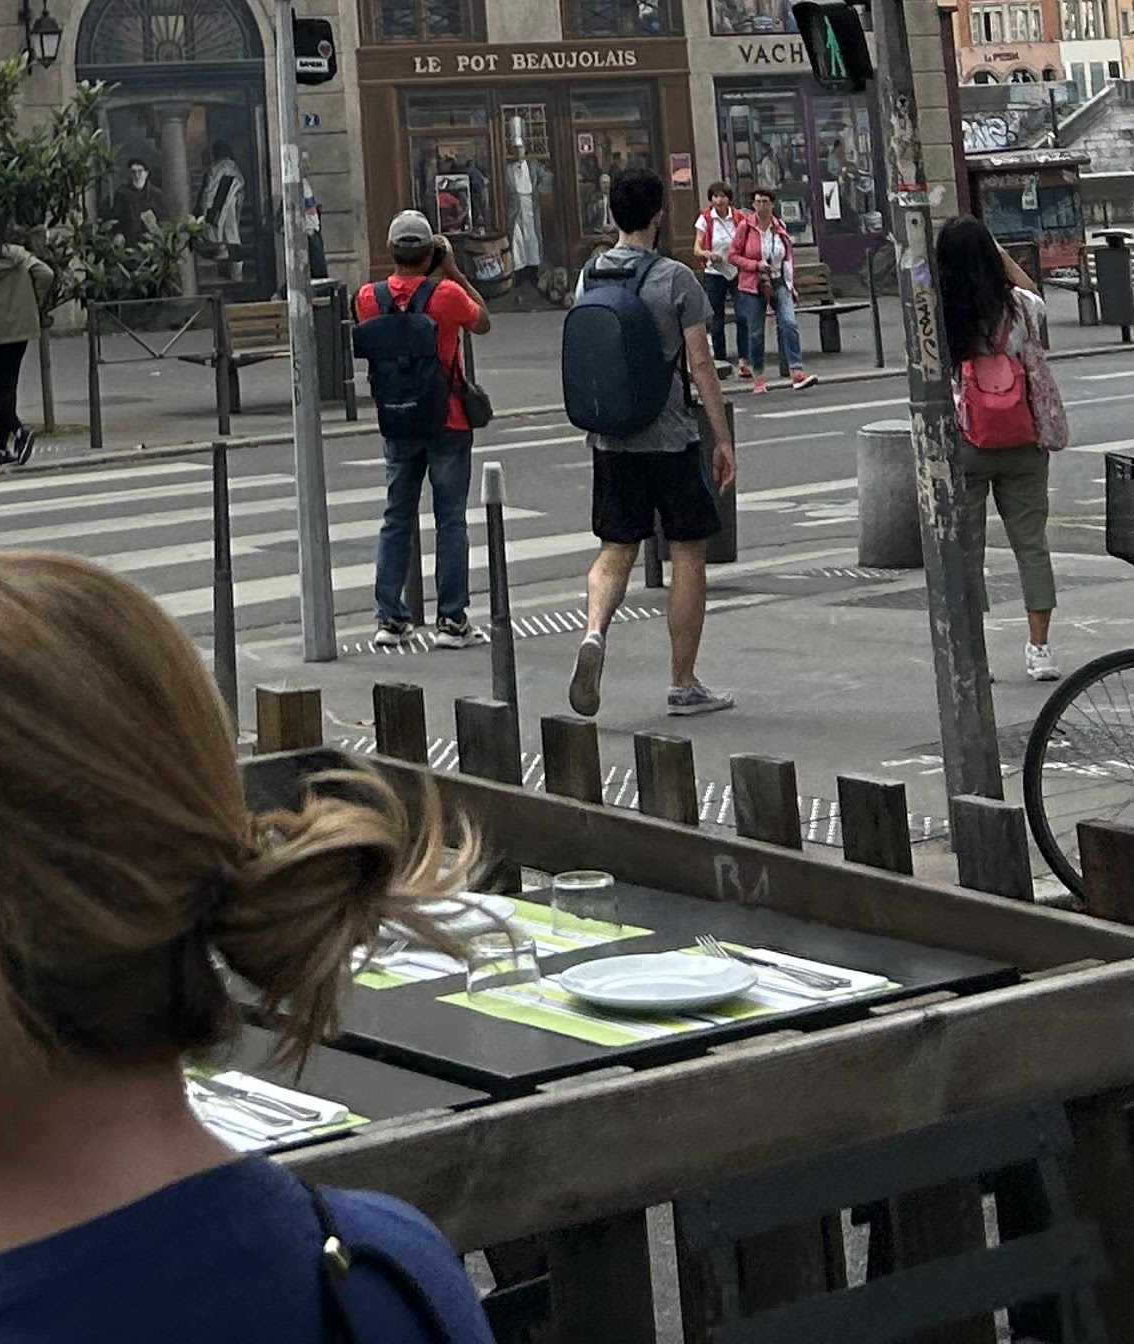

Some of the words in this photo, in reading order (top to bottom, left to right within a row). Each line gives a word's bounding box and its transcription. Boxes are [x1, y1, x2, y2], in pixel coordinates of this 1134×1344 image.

[414, 56, 441, 73] LE
[456, 54, 498, 72] POT
[511, 50, 637, 70] BEAUJOLAIS
